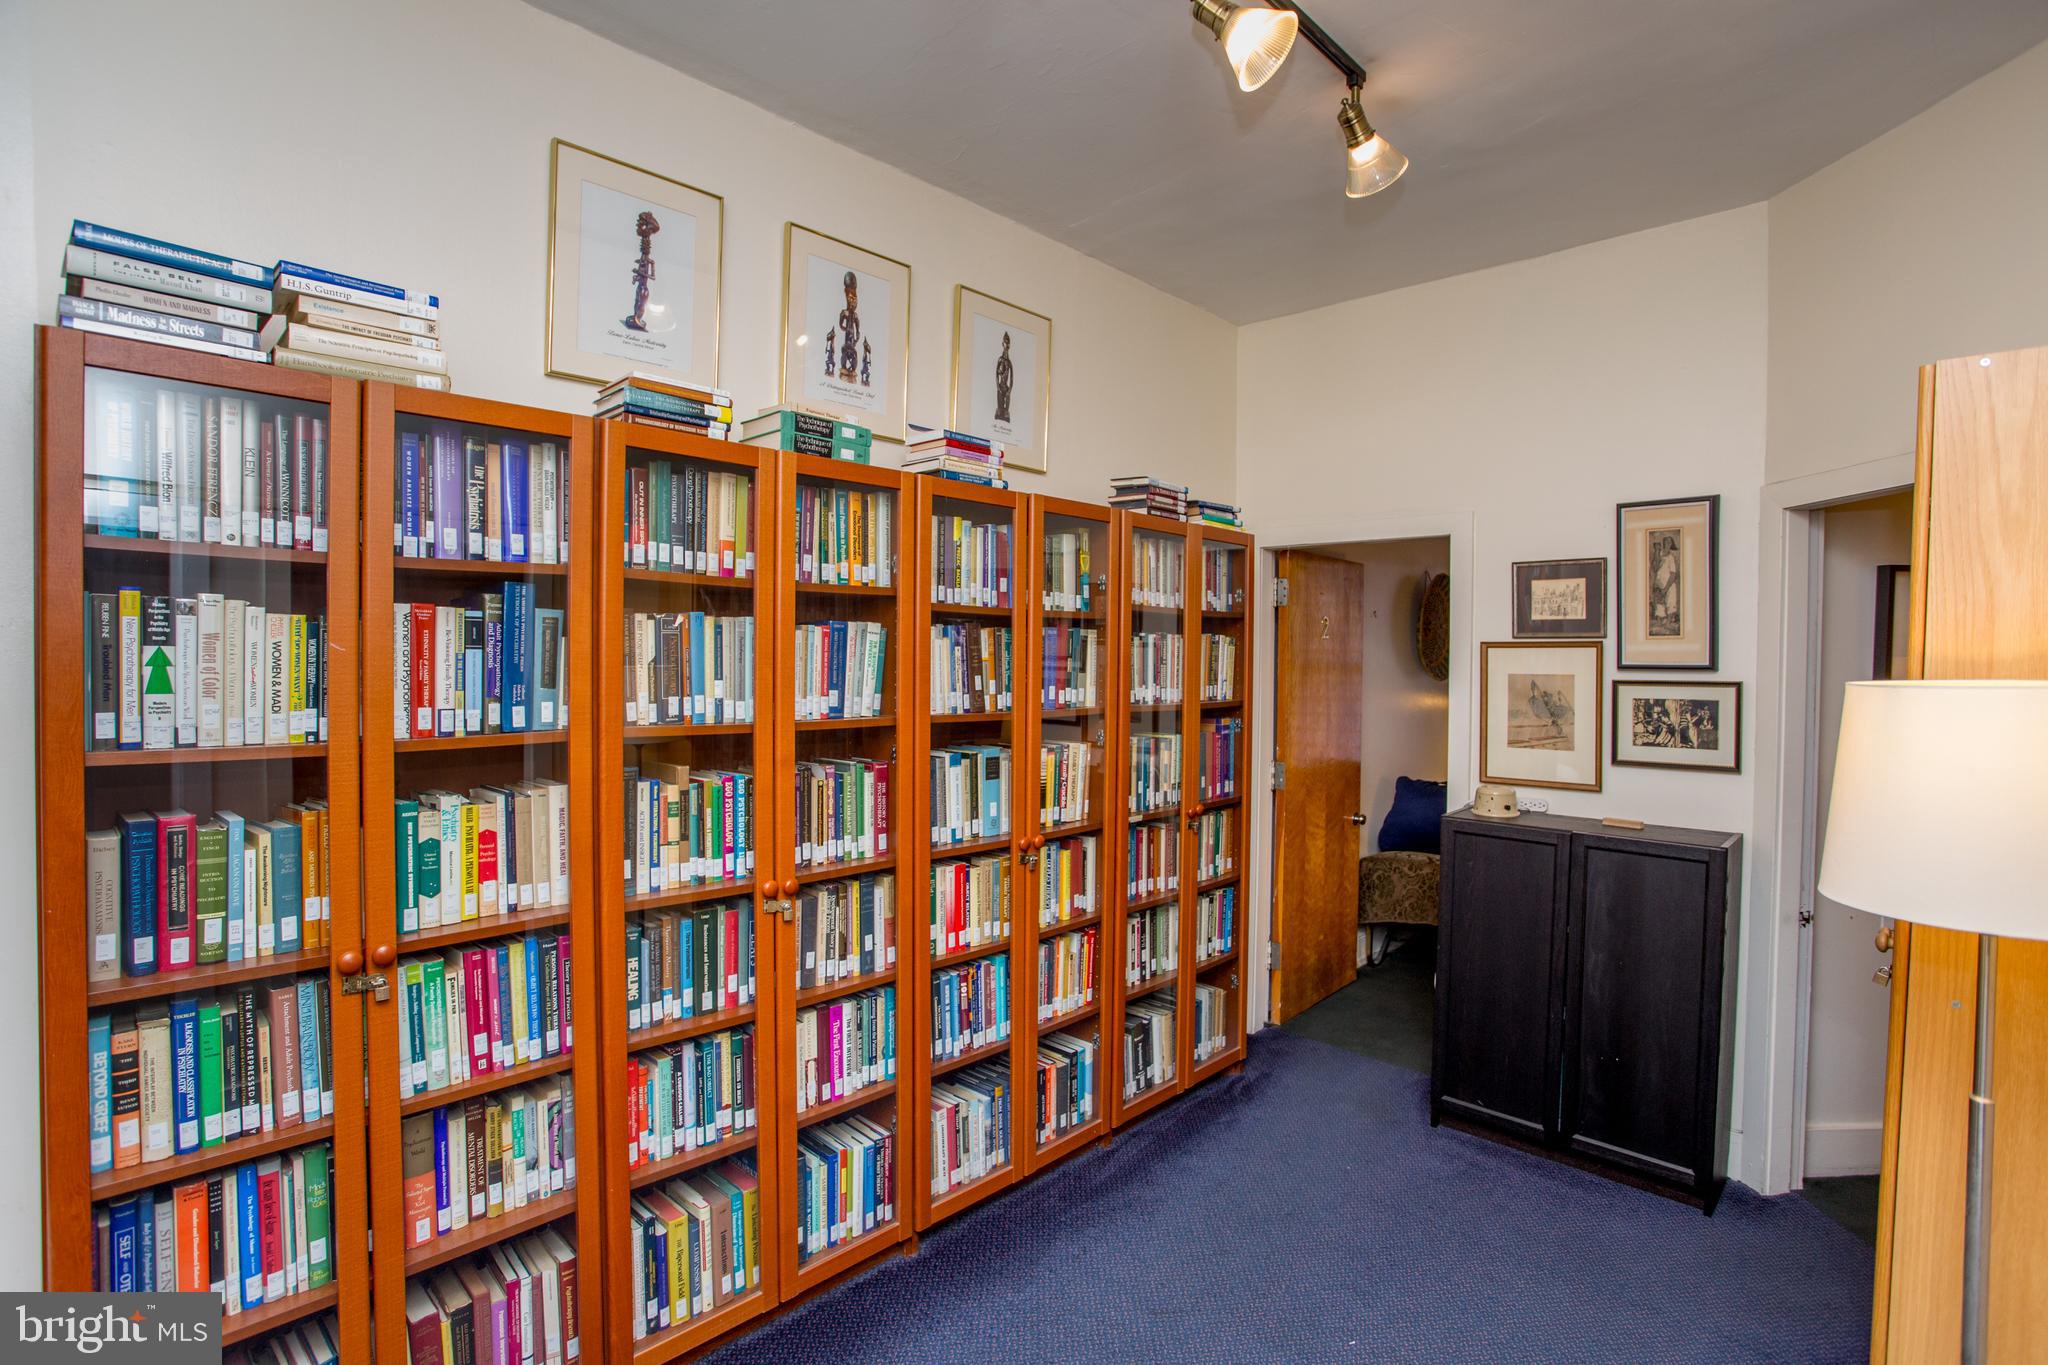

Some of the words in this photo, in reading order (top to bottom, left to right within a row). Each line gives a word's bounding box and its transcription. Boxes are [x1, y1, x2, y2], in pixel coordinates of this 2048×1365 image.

[103, 233, 134, 246] MODES
[149, 243, 208, 266] THERAPEUTIC
[113, 261, 160, 275] FALSE
[168, 273, 202, 283] SELF
[185, 281, 202, 293] Khan
[287, 279, 312, 292] H.J.S.
[315, 286, 352, 300] Guntrip
[143, 296, 166, 306] WOMEN
[182, 303, 210, 315] MADNESS
[313, 302, 344, 313] Existence
[107, 307, 156, 328] Madness
[170, 320, 204, 337] Streets
[329, 340, 350, 348] Scientific
[352, 344, 374, 353] Principles
[292, 357, 332, 369] Handbook
[377, 370, 412, 382] Psychiatry
[206, 415, 218, 462] SANDOR
[799, 422, 830, 434] Psychotherapy
[798, 442, 829, 454] Psychotherapy
[162, 452, 172, 482] Wilfred
[244, 447, 256, 478] KLEIN
[474, 465, 484, 479] The
[162, 484, 172, 502] Bion
[468, 480, 484, 530] Psychiatrists
[686, 486, 694, 524] Psychotherapy
[101, 603, 109, 625] REUBEN
[102, 626, 110, 638] FINE
[126, 618, 136, 635] New
[402, 612, 411, 647] Women
[1321, 616, 1329, 638] 2
[201, 633, 221, 664] Women
[250, 642, 258, 666] WOMEN
[308, 639, 316, 656] WOMEN
[103, 644, 112, 680] Troubled
[123, 637, 136, 687] Psychotherapy
[199, 666, 221, 675] of
[272, 641, 281, 679] WOMEN
[308, 663, 317, 684] THERAPY
[103, 683, 111, 701] Men
[126, 688, 136, 699] for
[202, 677, 221, 700] Color
[126, 701, 136, 716] Men
[725, 782, 733, 796] EGO
[442, 819, 450, 842] Ethics
[450, 804, 459, 842] Psychiatry
[95, 872, 103, 934] PSYCHOANALYSIS
[628, 957, 639, 1000] HEALING
[283, 1001, 292, 1034] Attachment
[184, 1022, 193, 1055] DIAGNOSIS
[247, 1037, 254, 1048] OF
[285, 1047, 293, 1064] Adult
[93, 1052, 108, 1098] BEYOND
[178, 1056, 186, 1094] PSYCHIATRY
[247, 1050, 255, 1097] REPRESSED
[186, 1069, 195, 1117] CLASSIFICATION
[94, 1100, 109, 1133] GRIEF
[467, 1132, 475, 1158] MENTAL
[476, 1136, 484, 1175] TREATMENT
[468, 1160, 476, 1196] DISORDERS
[478, 1177, 484, 1185] OF
[144, 1223, 152, 1234] Body
[119, 1235, 131, 1259] SELF
[144, 1235, 153, 1246] Self
